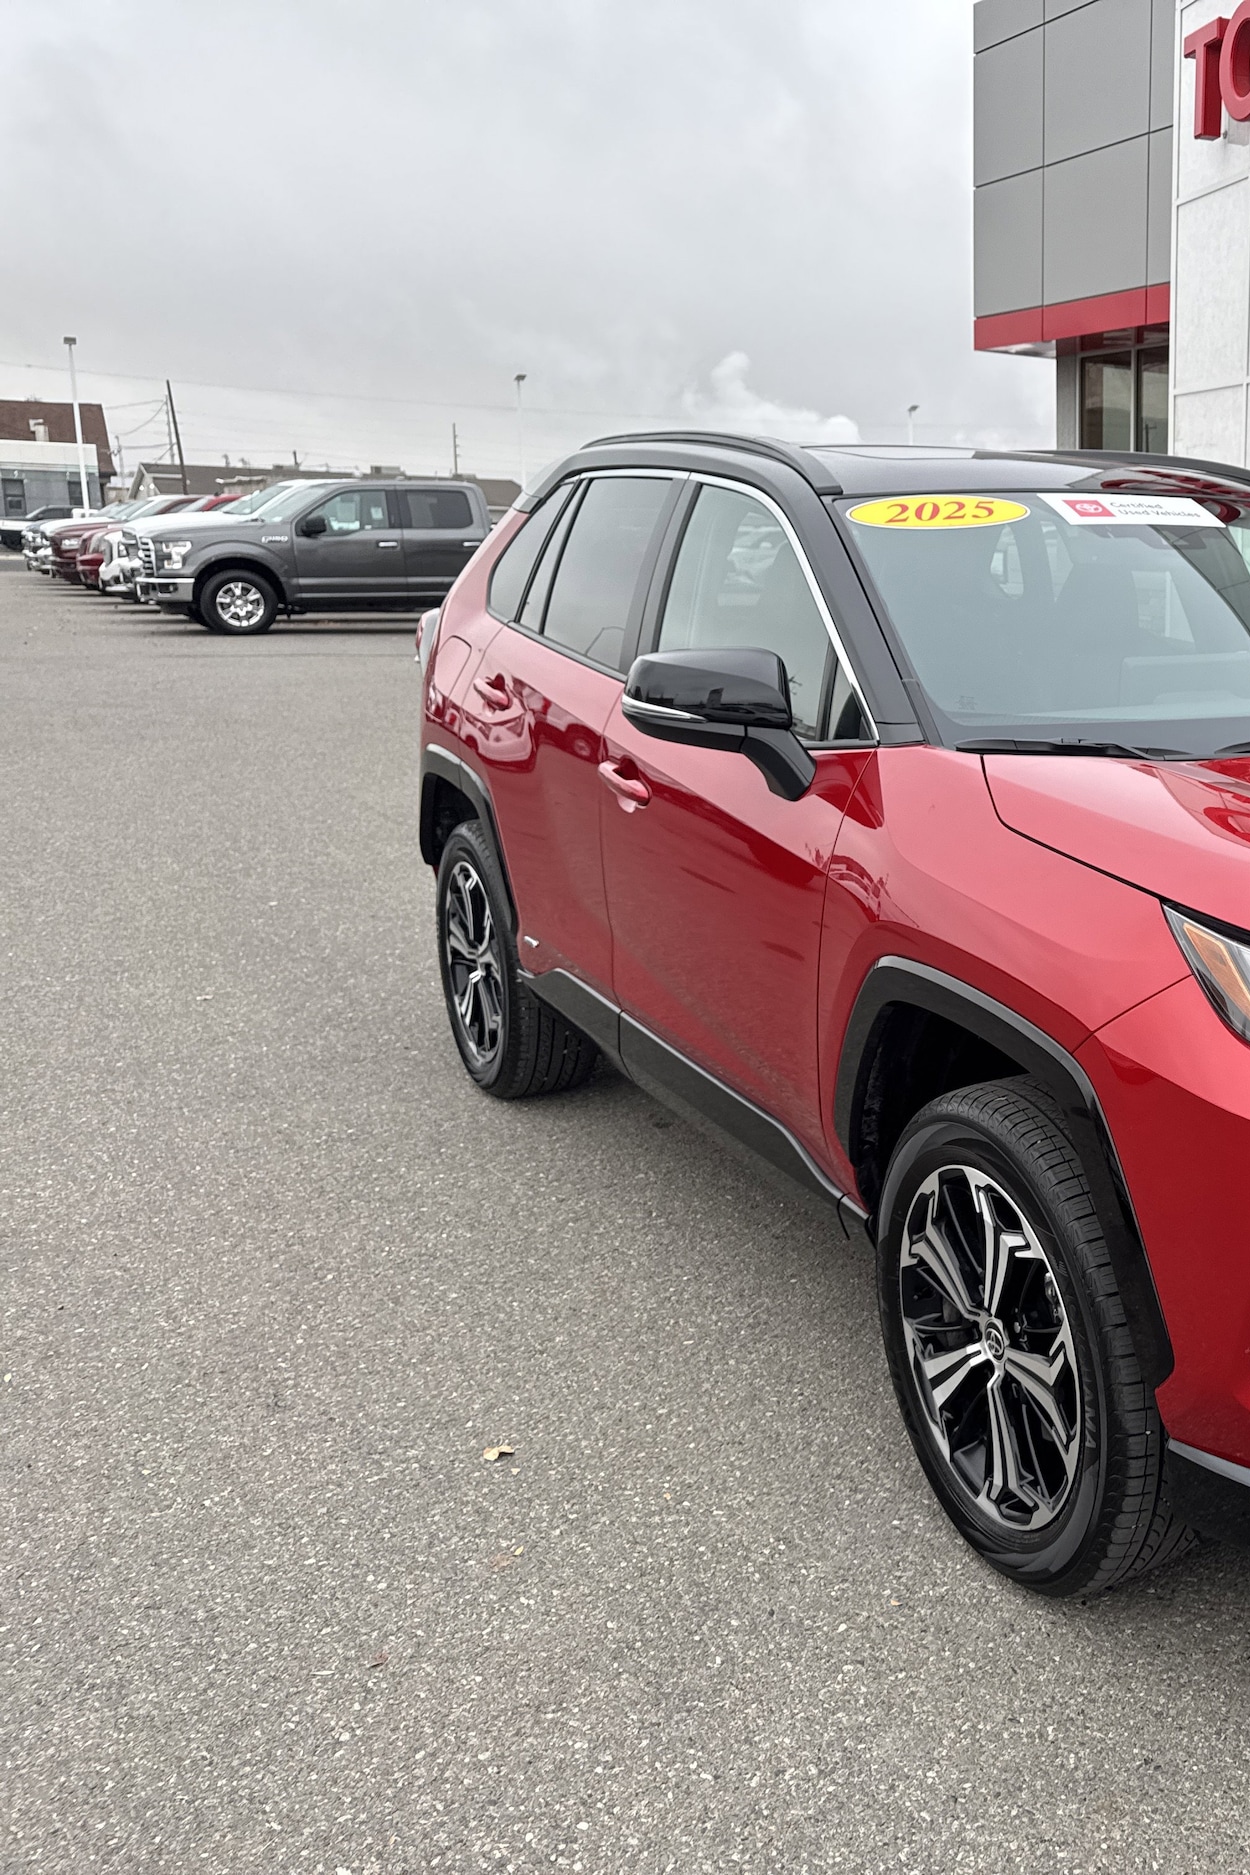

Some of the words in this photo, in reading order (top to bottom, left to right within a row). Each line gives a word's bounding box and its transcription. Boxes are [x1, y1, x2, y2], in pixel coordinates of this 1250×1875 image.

[1110, 502, 1163, 510] Certified
[885, 501, 995, 524] 2025
[1151, 510, 1201, 518] Vehicles
